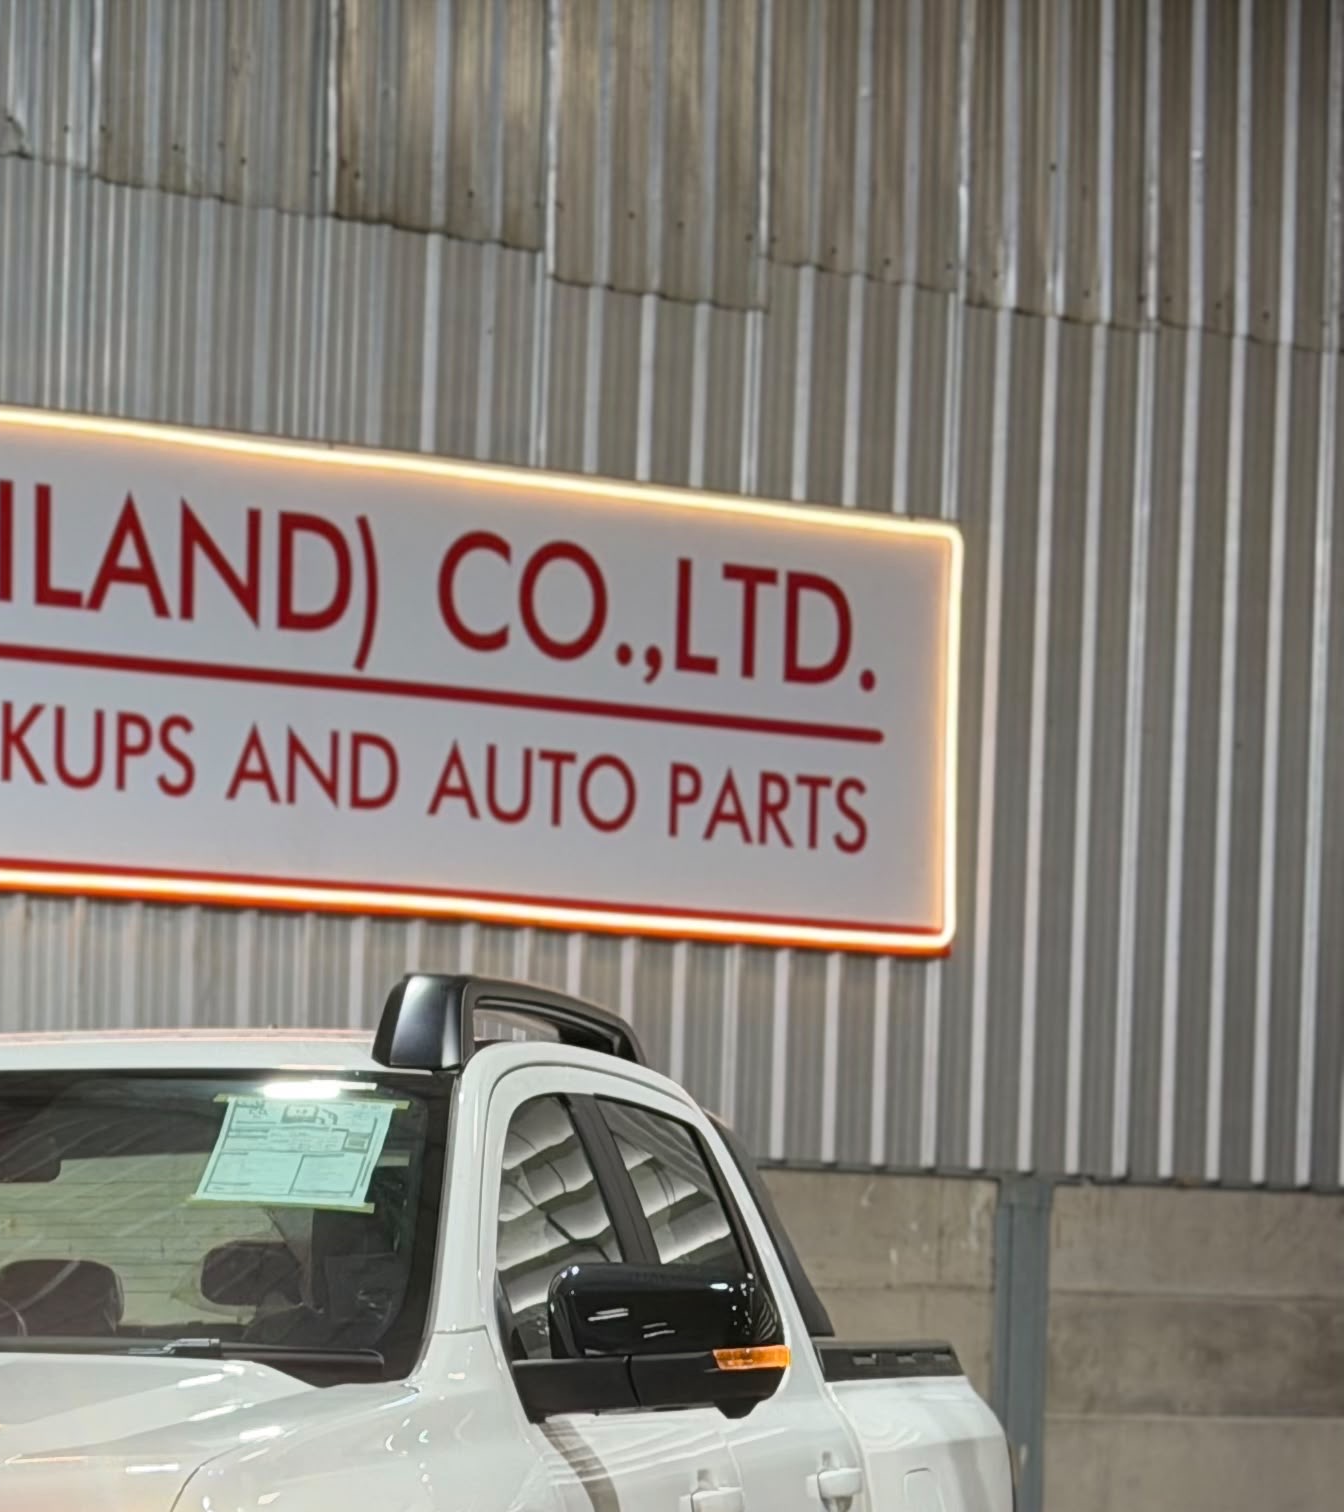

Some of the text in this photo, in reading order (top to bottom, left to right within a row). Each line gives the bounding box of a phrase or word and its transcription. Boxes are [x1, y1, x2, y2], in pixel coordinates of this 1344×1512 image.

[436, 528, 878, 694] CO.,LTD.
[225, 724, 401, 812] AND
[426, 741, 638, 834] AUTO
[667, 761, 869, 856] PARTS
